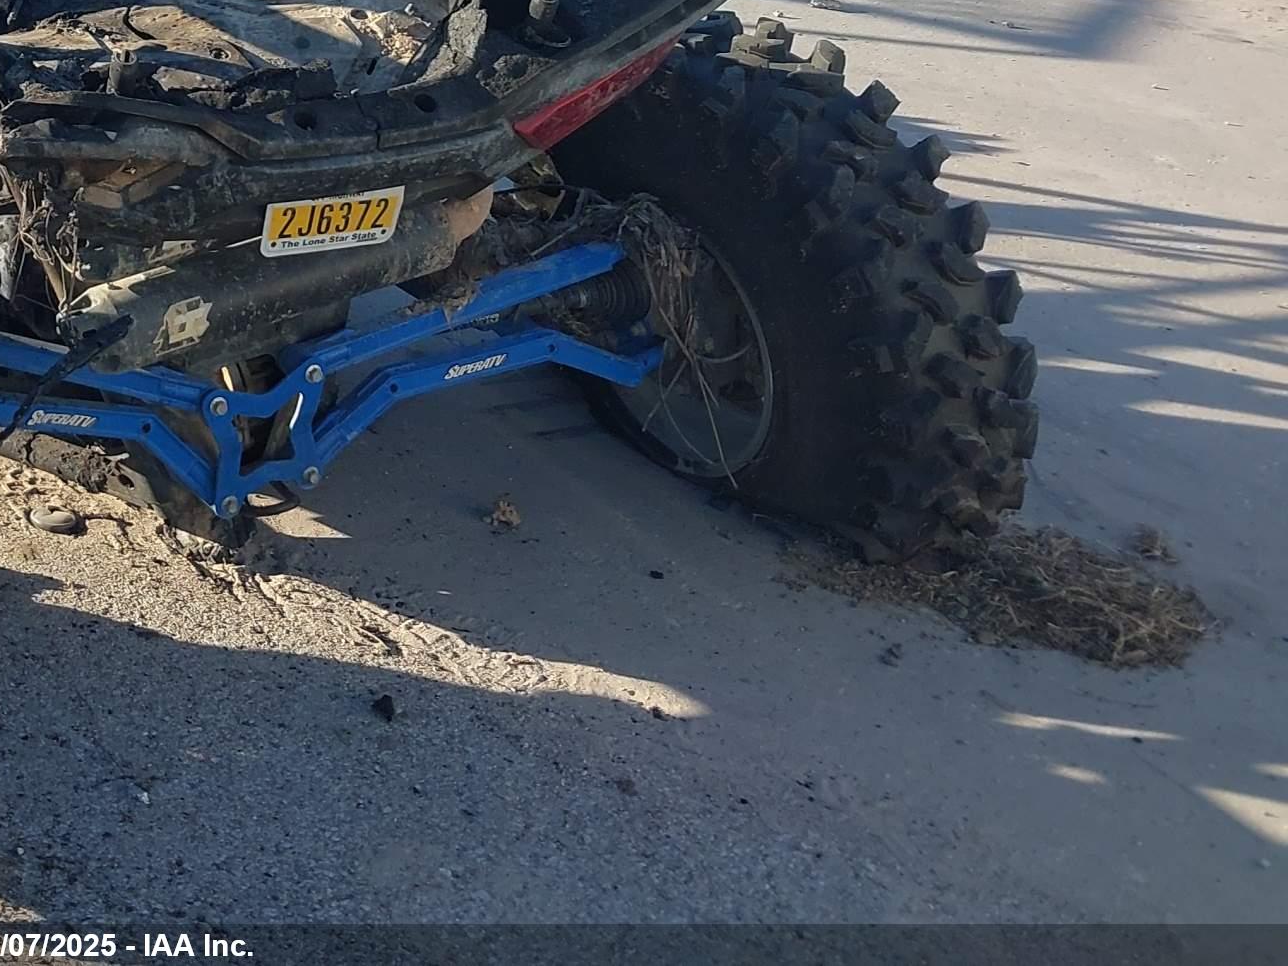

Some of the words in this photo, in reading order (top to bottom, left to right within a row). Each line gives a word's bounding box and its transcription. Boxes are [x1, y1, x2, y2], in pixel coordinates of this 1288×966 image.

[278, 199, 389, 239] 2J6372
[280, 240, 299, 249] The
[302, 236, 326, 246] Lone
[328, 234, 348, 243] Star
[351, 232, 377, 241] State
